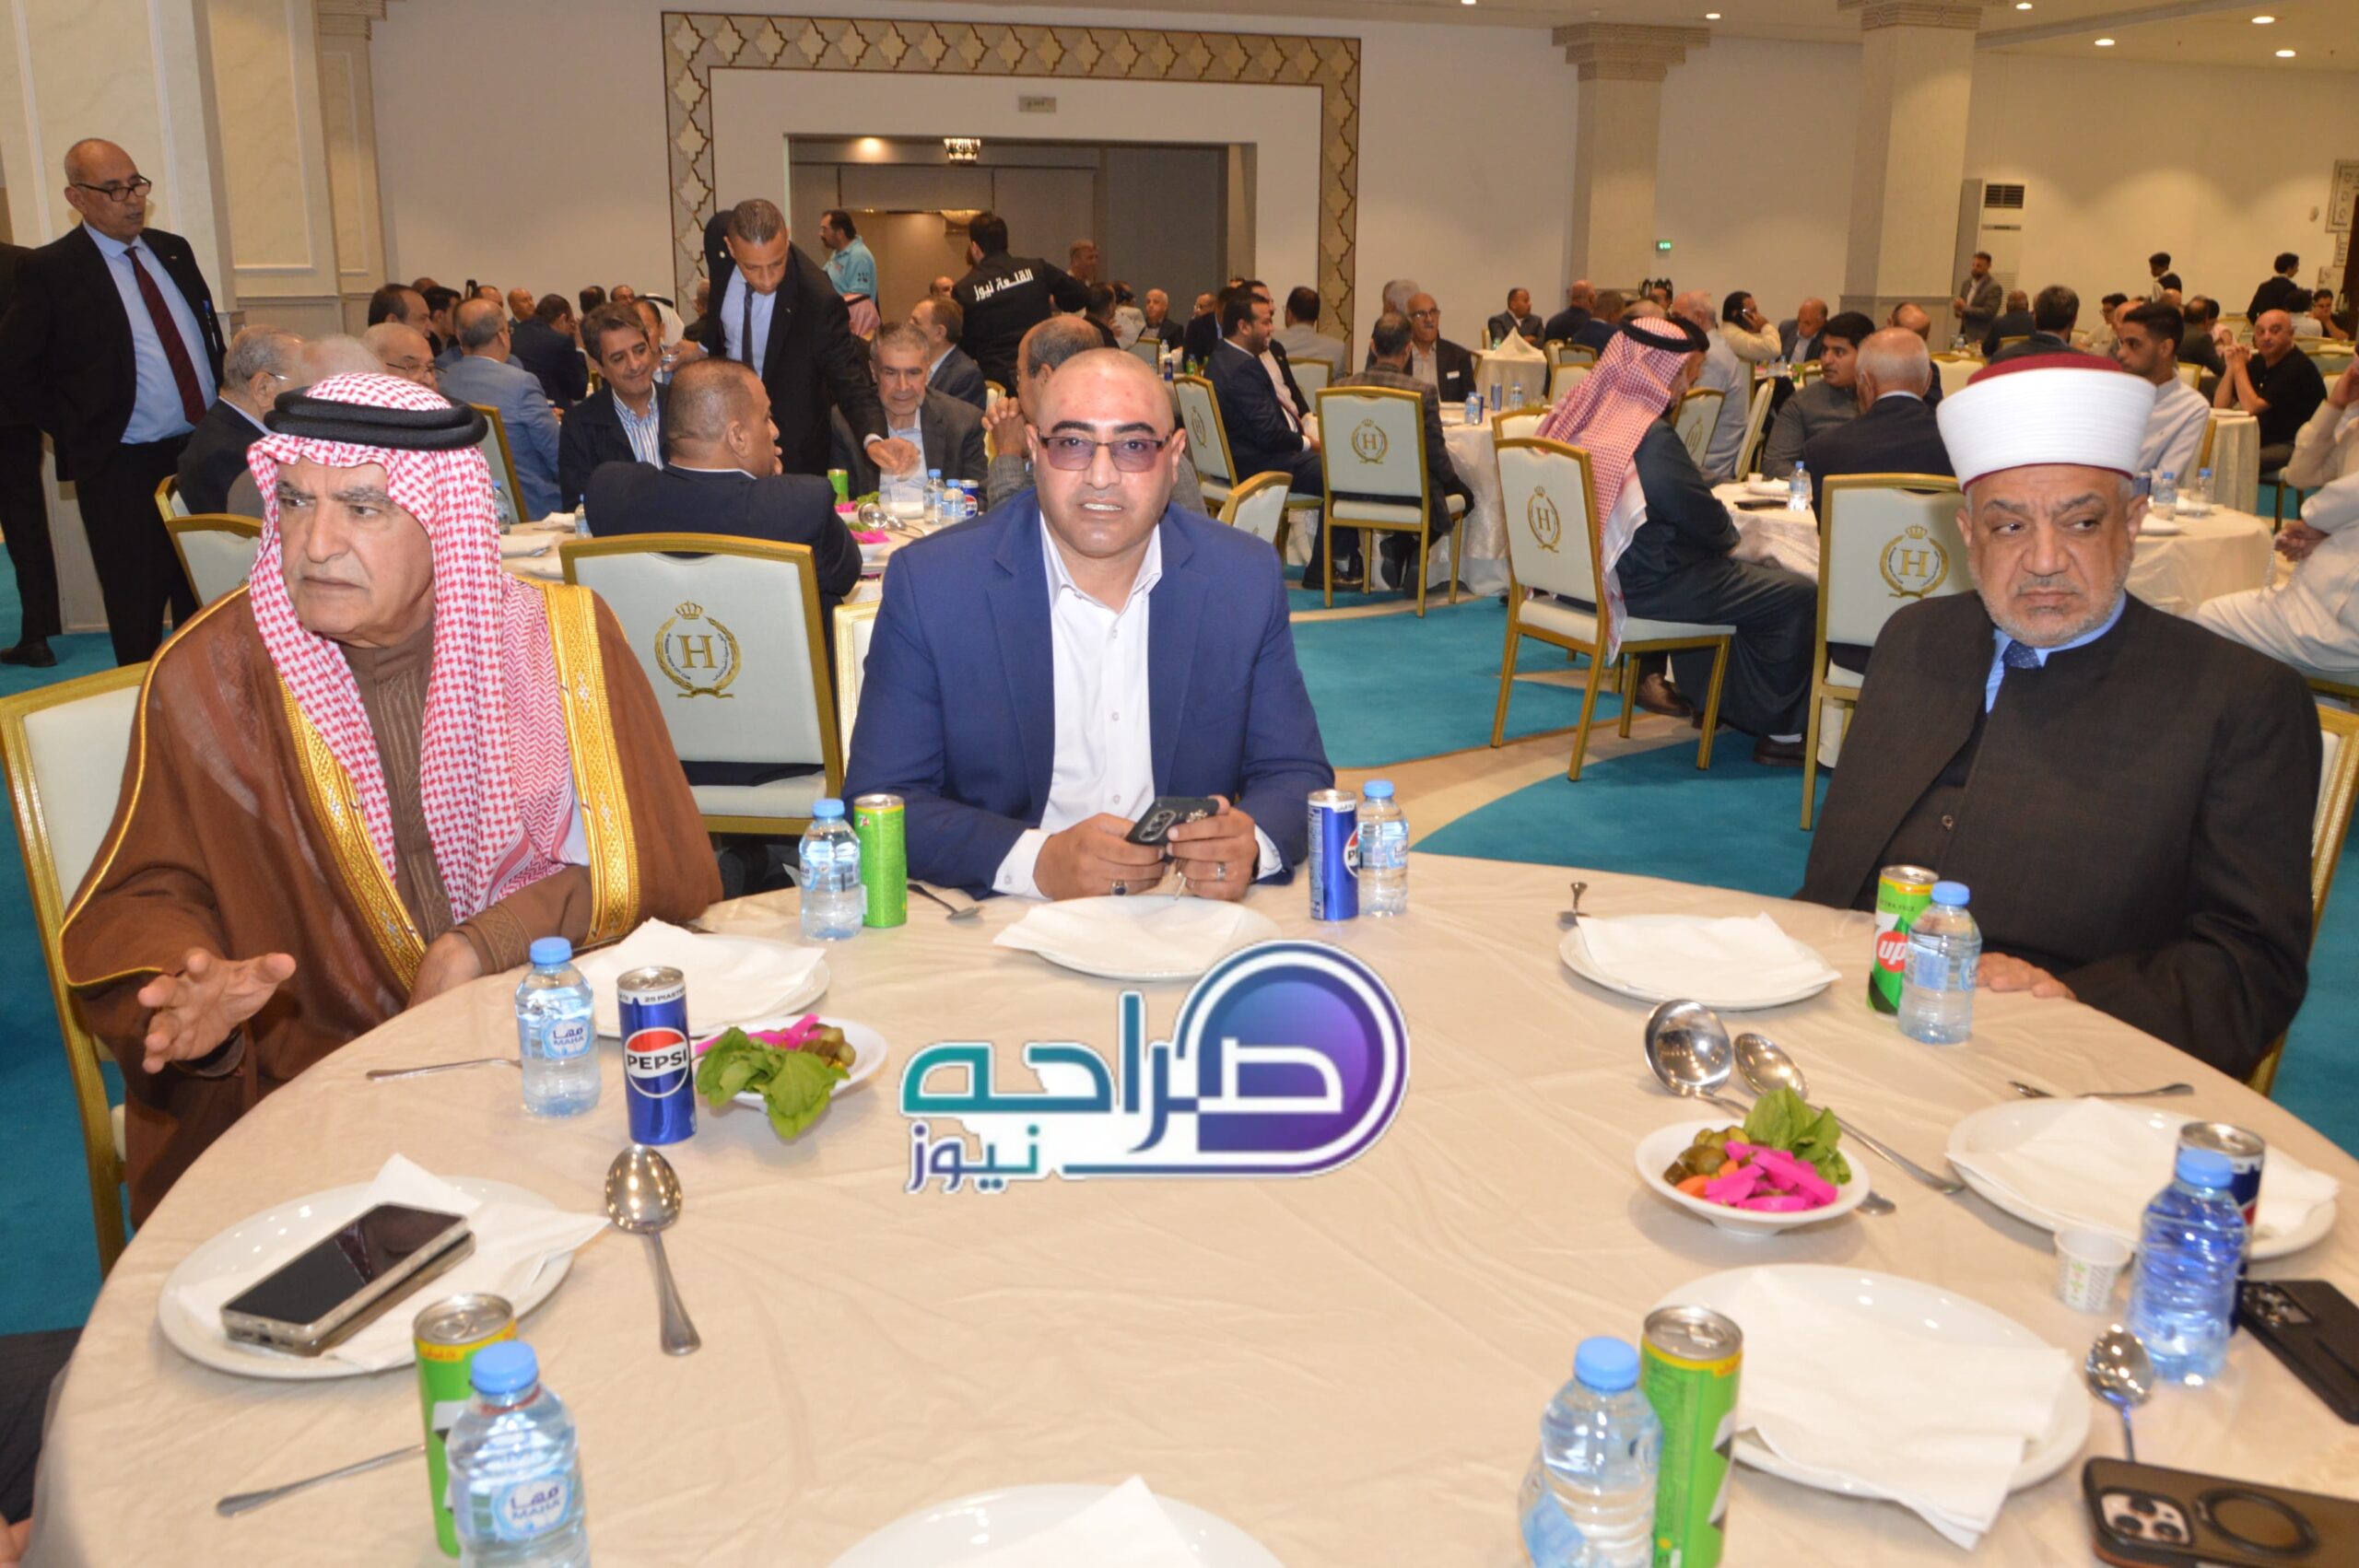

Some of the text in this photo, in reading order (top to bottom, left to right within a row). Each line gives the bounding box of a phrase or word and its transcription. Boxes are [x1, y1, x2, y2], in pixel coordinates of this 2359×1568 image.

[973, 280, 994, 302] نيوز
[1361, 433, 1377, 450] H
[1536, 507, 1551, 532] H
[1898, 548, 1931, 578] H
[676, 635, 718, 669] H
[553, 1026, 583, 1039] مها
[553, 1036, 584, 1047] MAHA
[627, 1048, 687, 1071] PEPSI
[511, 1486, 559, 1510] مها
